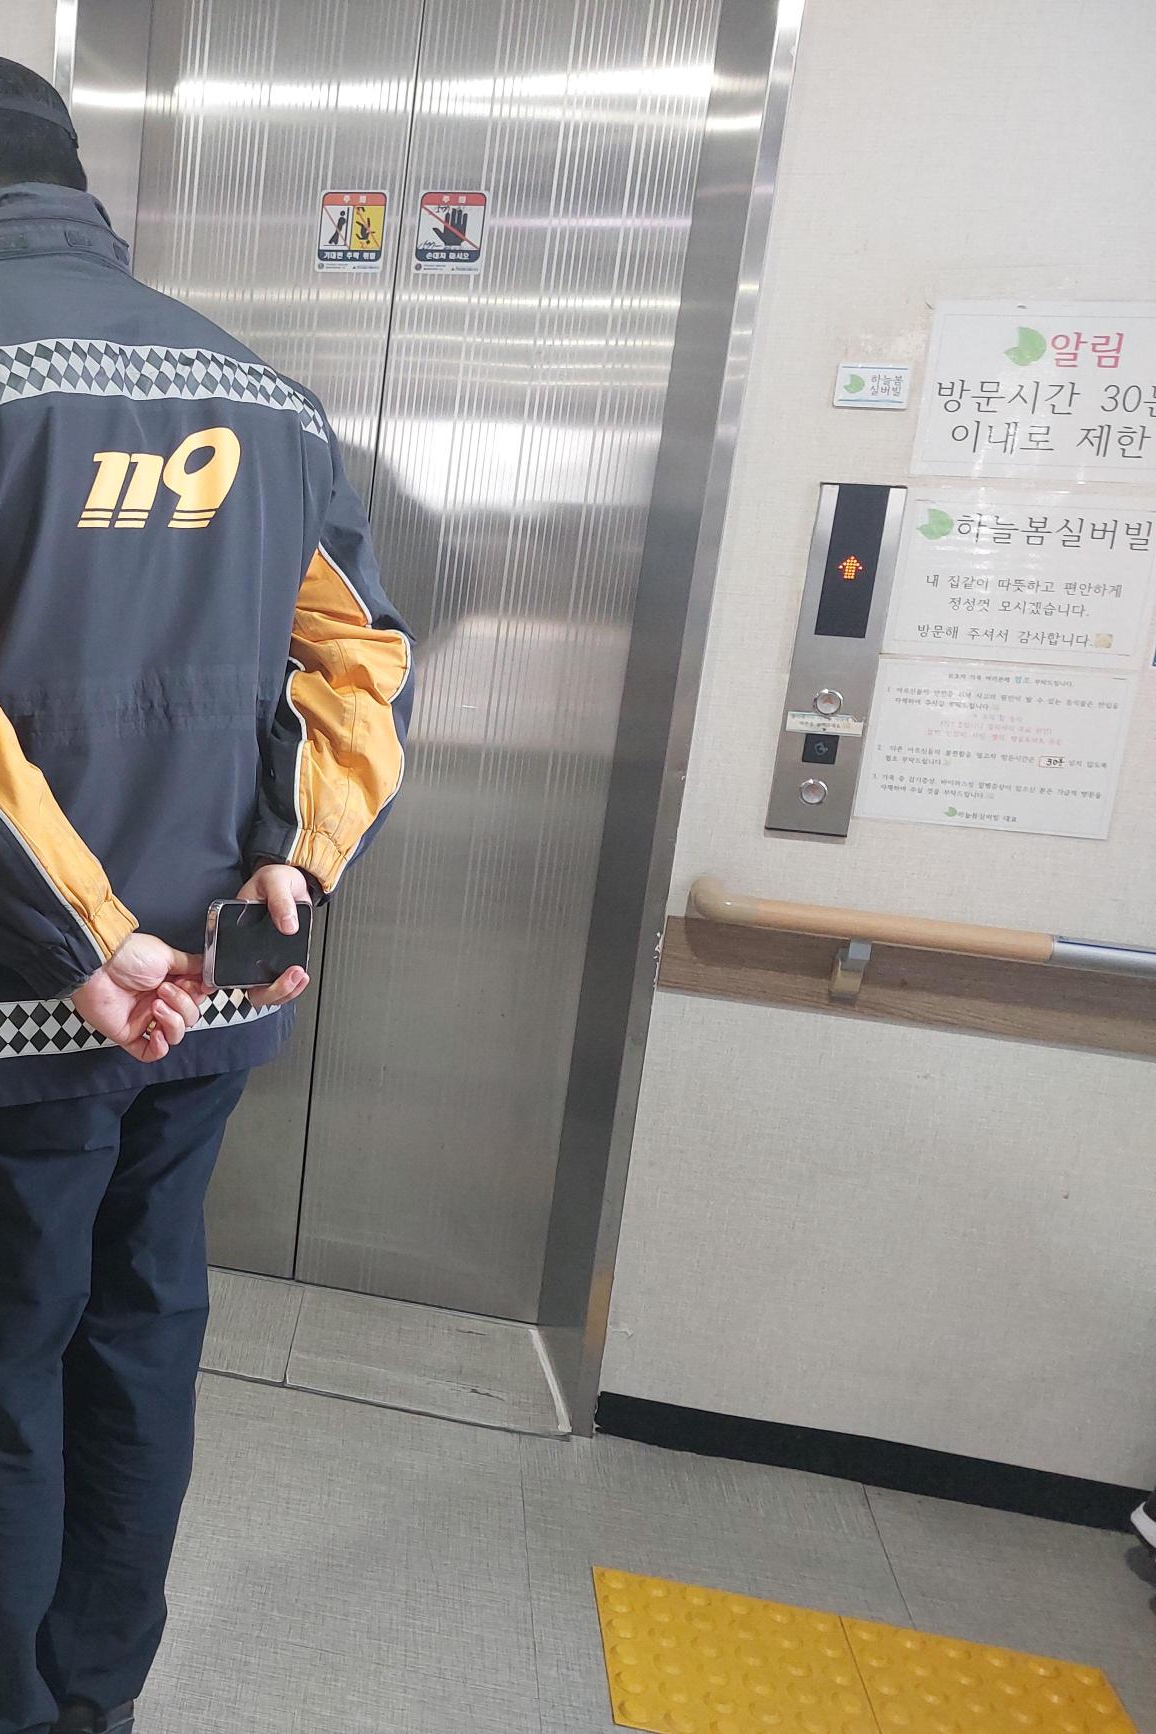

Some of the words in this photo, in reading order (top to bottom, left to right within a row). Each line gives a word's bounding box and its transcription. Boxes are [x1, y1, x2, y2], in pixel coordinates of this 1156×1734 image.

[1051, 332, 1124, 368] 알림
[937, 379, 1081, 415] 방문시간
[951, 420, 1054, 455] 이내로
[1076, 424, 1151, 459] 제한
[76, 427, 241, 528] 119
[957, 512, 1153, 551] 하늘봄실버빌
[926, 575, 939, 588] 내
[948, 575, 989, 590] 집같이
[998, 578, 1055, 594] 따뜻하고
[1064, 582, 1122, 598] 편안하게
[948, 597, 990, 612] 정성껏
[998, 602, 1090, 617] 모시겠습니다.
[917, 624, 959, 639] 방문해
[968, 627, 1009, 642] 주셔서
[1018, 630, 1093, 647] 감사합니다.
